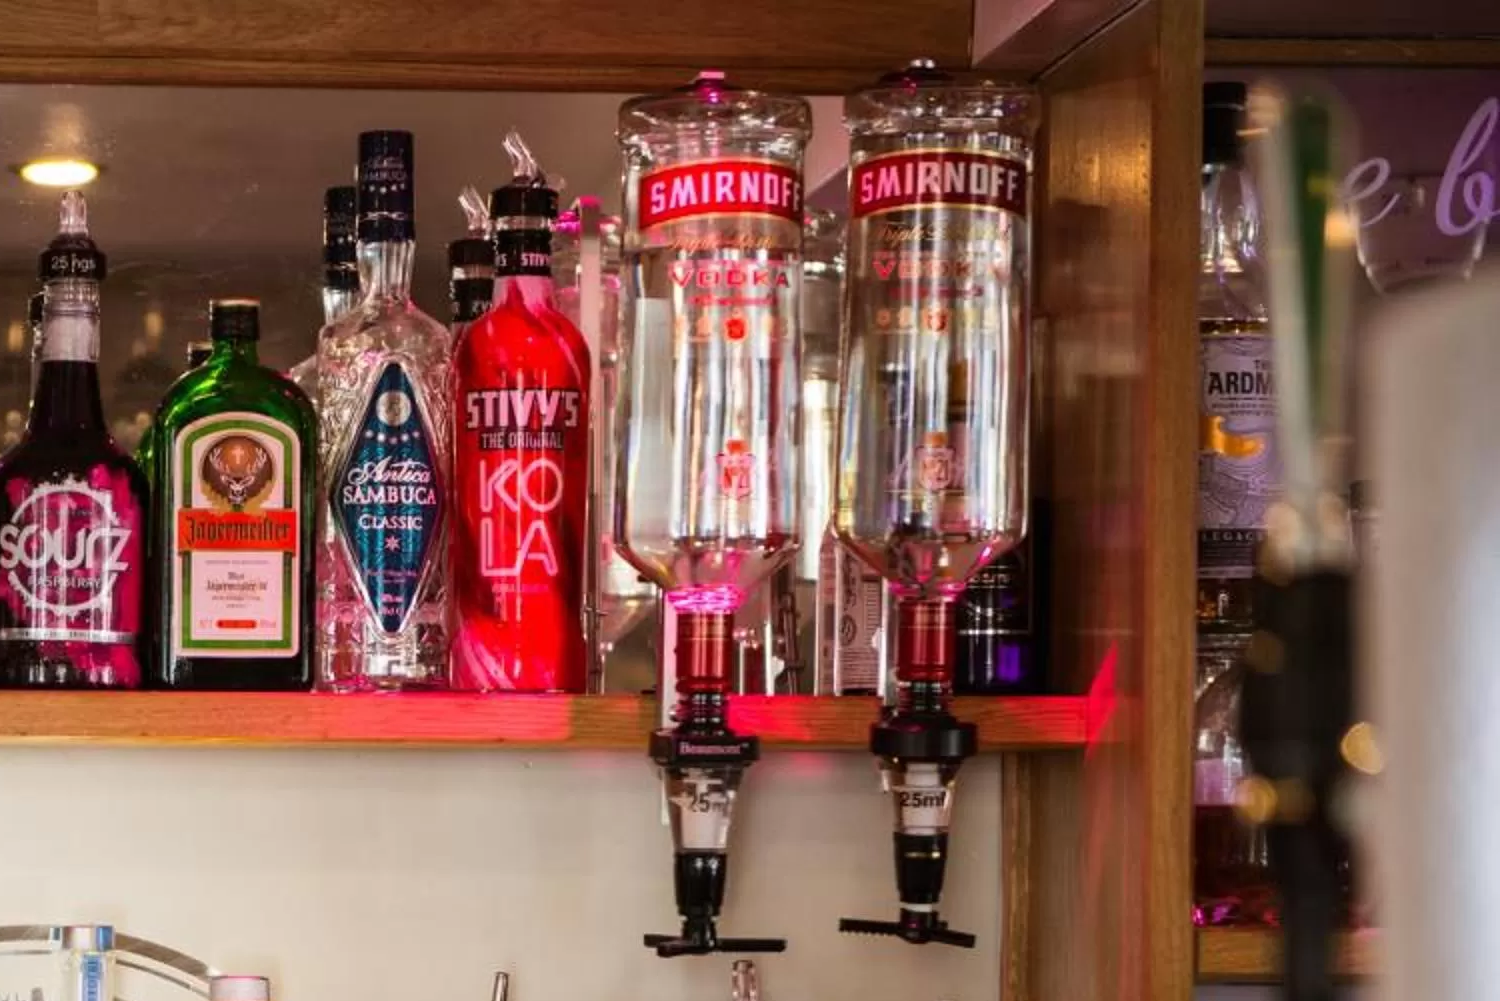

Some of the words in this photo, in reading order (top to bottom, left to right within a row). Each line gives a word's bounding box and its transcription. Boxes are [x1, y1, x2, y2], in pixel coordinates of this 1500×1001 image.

[650, 170, 800, 215] SMIRNOFF
[861, 160, 1019, 205] SMIRNOFF
[1208, 371, 1276, 395] ARDM
[466, 389, 580, 429] STIVY'S
[481, 432, 504, 449] THE
[508, 432, 564, 450] ORIGINAL
[342, 486, 437, 506] SAMBUCA
[357, 513, 423, 531] CLASSIC
